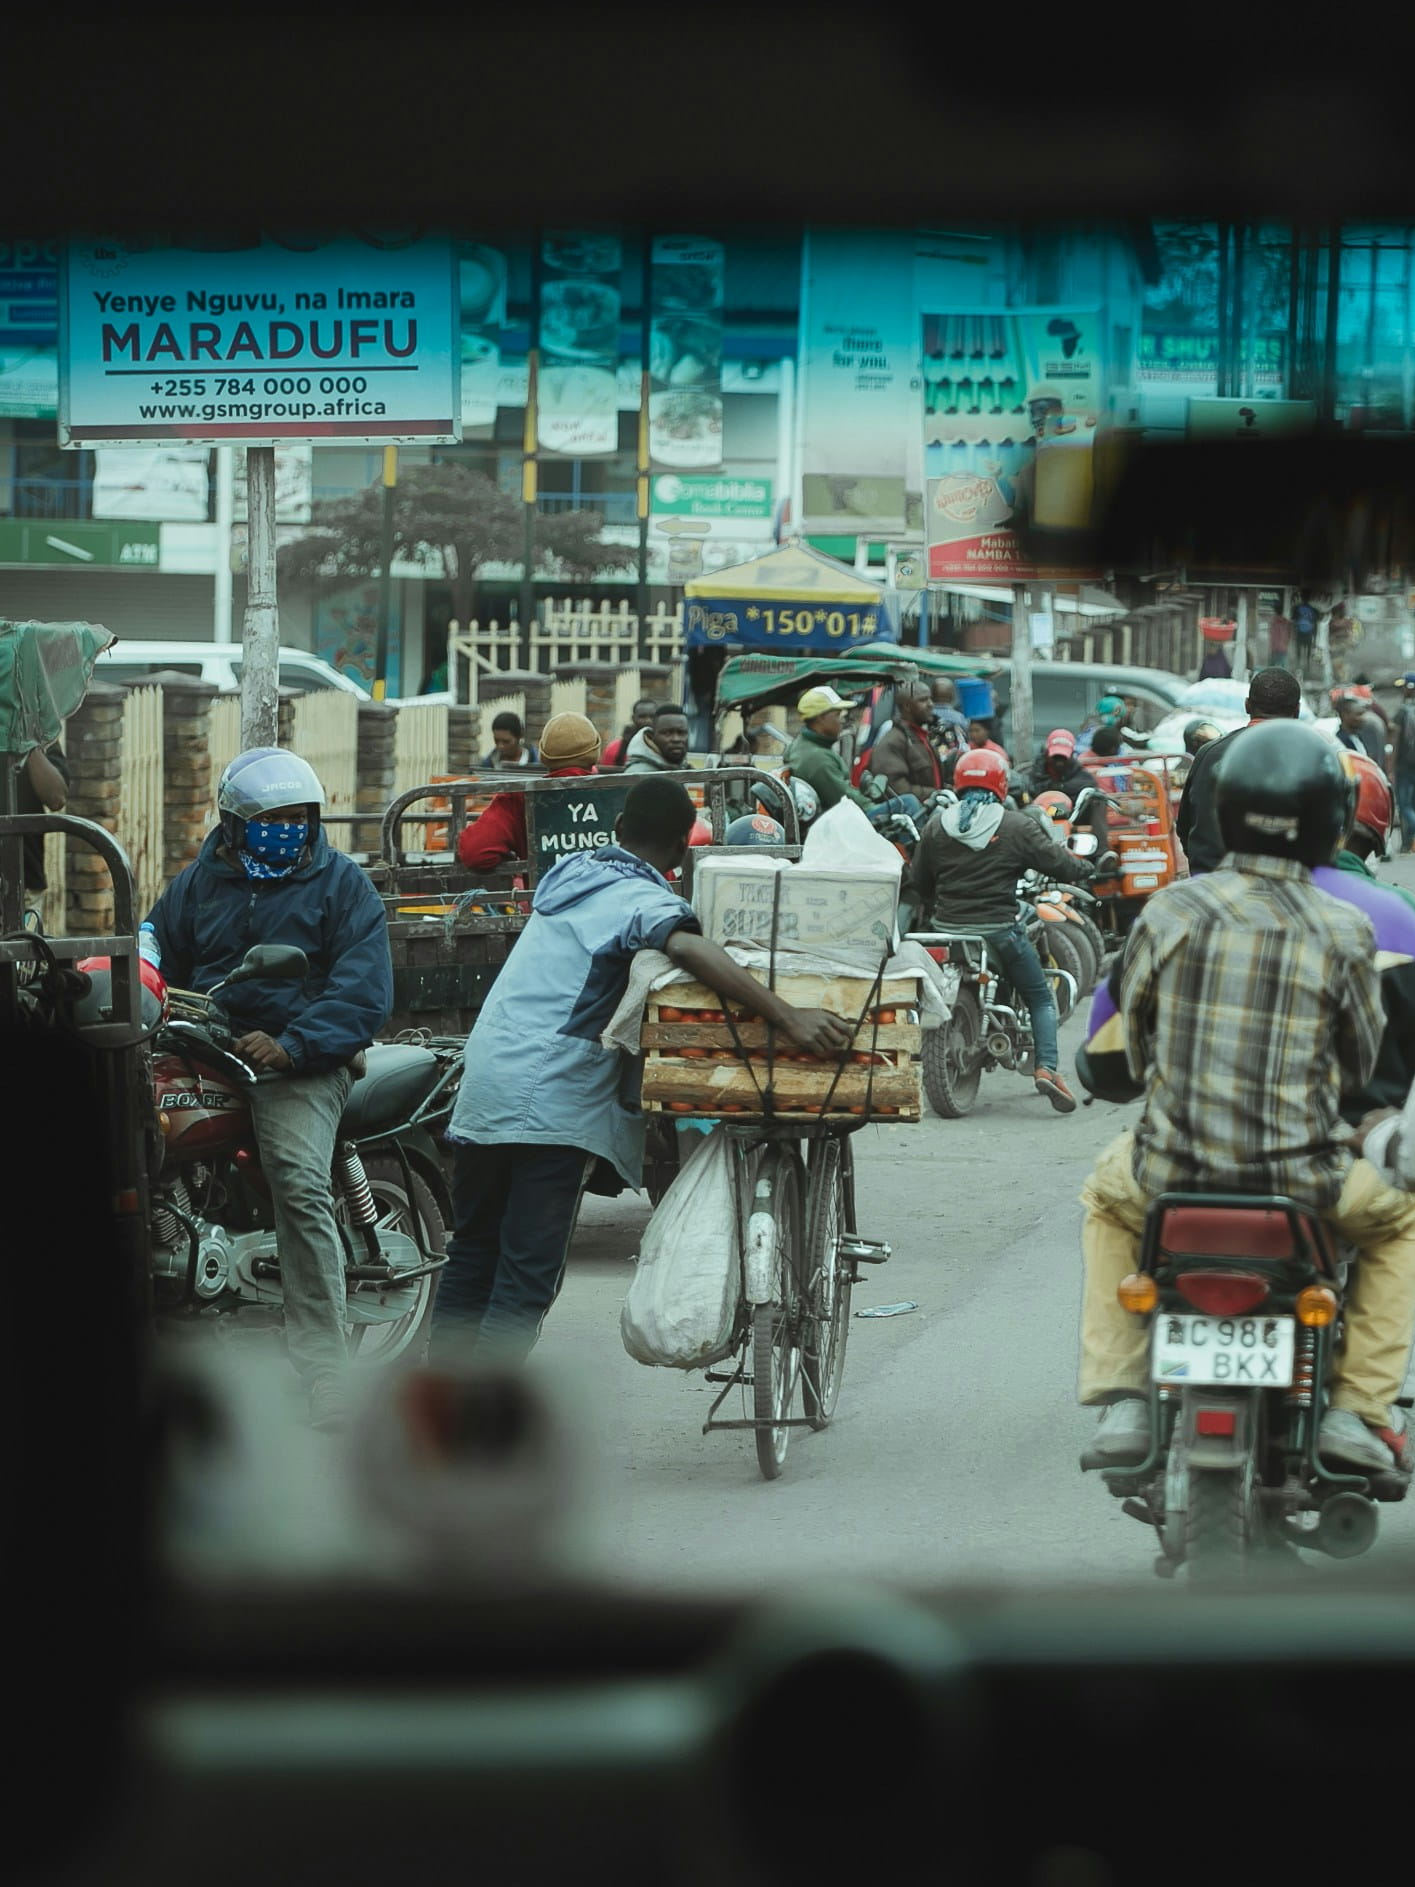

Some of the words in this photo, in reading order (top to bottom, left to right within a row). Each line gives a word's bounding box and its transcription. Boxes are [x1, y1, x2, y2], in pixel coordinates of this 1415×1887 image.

[93, 290, 176, 317] Yenye
[187, 290, 285, 316] Nguvu,
[295, 290, 327, 311] na
[337, 287, 416, 311] Imara
[102, 319, 417, 362] MARADUFU
[150, 378, 206, 397] +255
[214, 378, 256, 397] 784
[263, 377, 311, 396] 000
[319, 376, 367, 395] 000
[139, 398, 387, 421] www.gsmgroup.africa
[119, 543, 157, 563] ATM
[980, 537, 1018, 549] Mabat
[966, 549, 1012, 561] NAMBA
[688, 605, 738, 640] Piga
[567, 803, 599, 823] YA
[160, 1092, 226, 1109] BOXER
[1213, 1352, 1278, 1380] BKX
